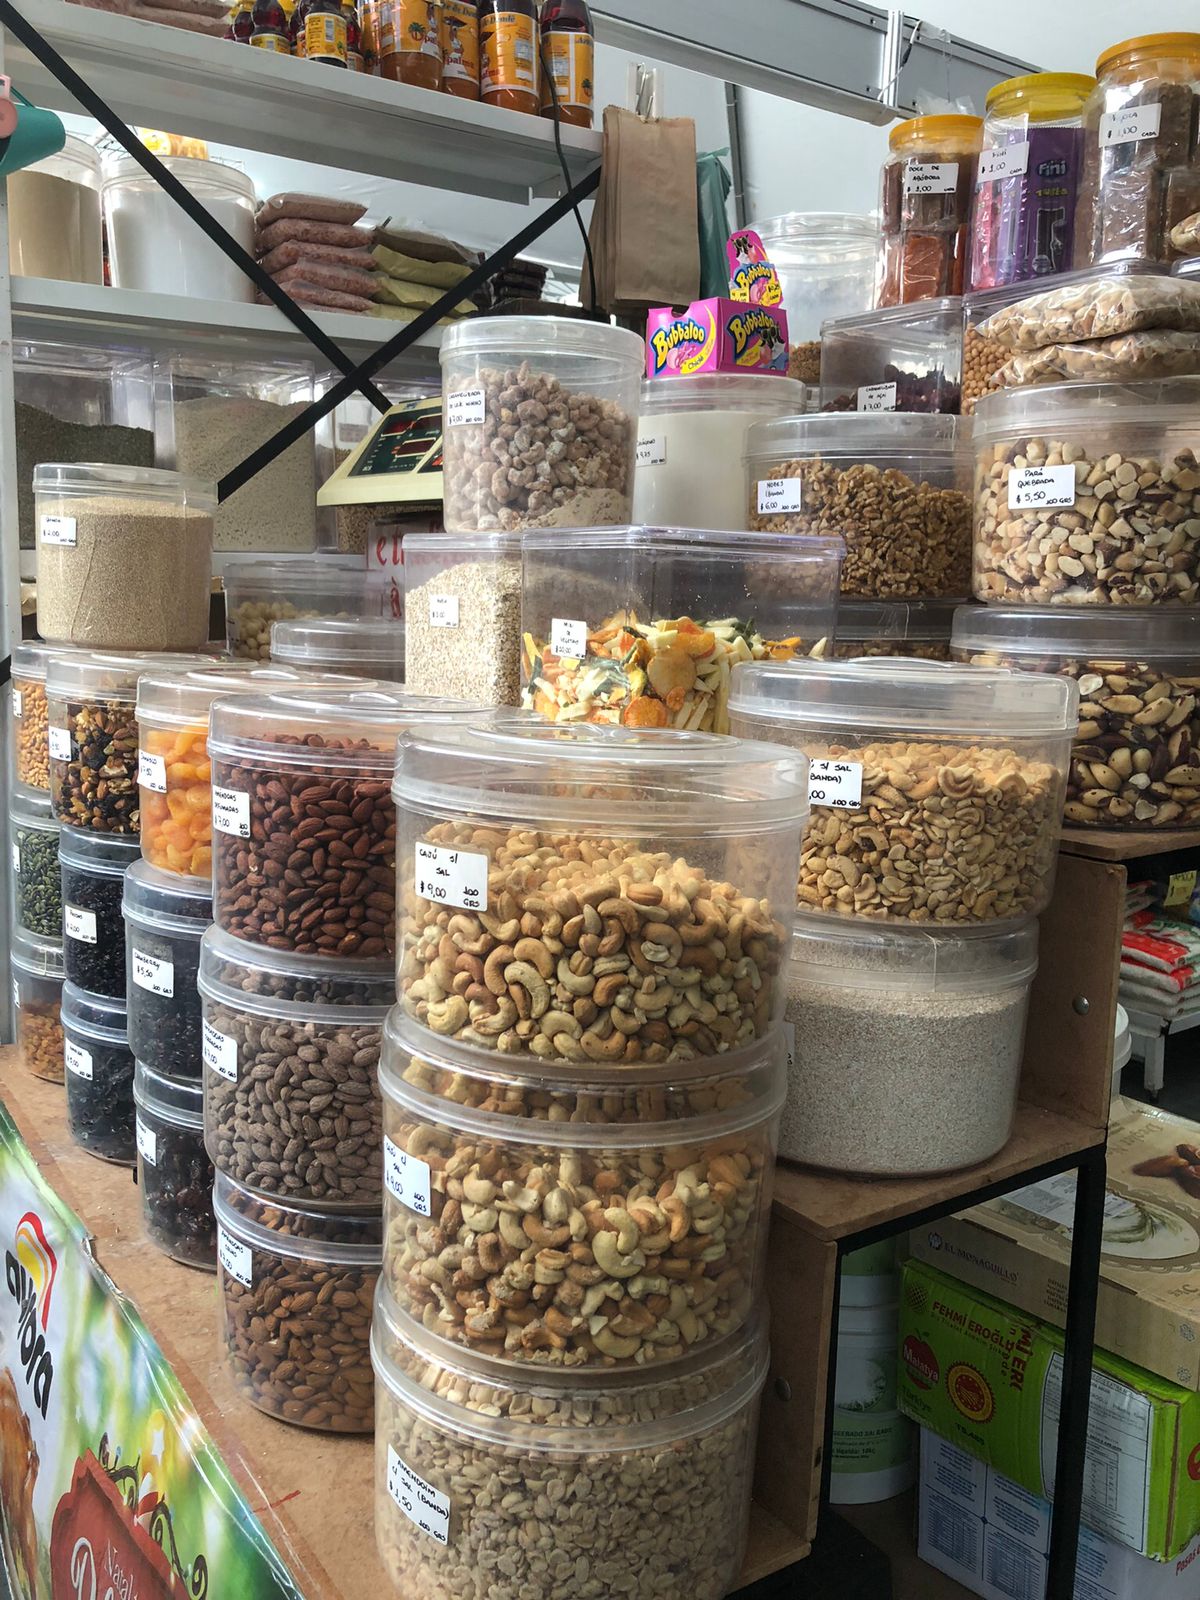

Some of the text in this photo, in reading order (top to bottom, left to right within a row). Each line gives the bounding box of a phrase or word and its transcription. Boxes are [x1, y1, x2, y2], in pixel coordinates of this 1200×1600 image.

[1039, 160, 1066, 175] Fini
[653, 320, 705, 369] Bubbaloo
[729, 310, 774, 354] Bubbaloo
[834, 764, 852, 772] SAL
[436, 867, 450, 876] SAL
[903, 1343, 939, 1381] Malatya
